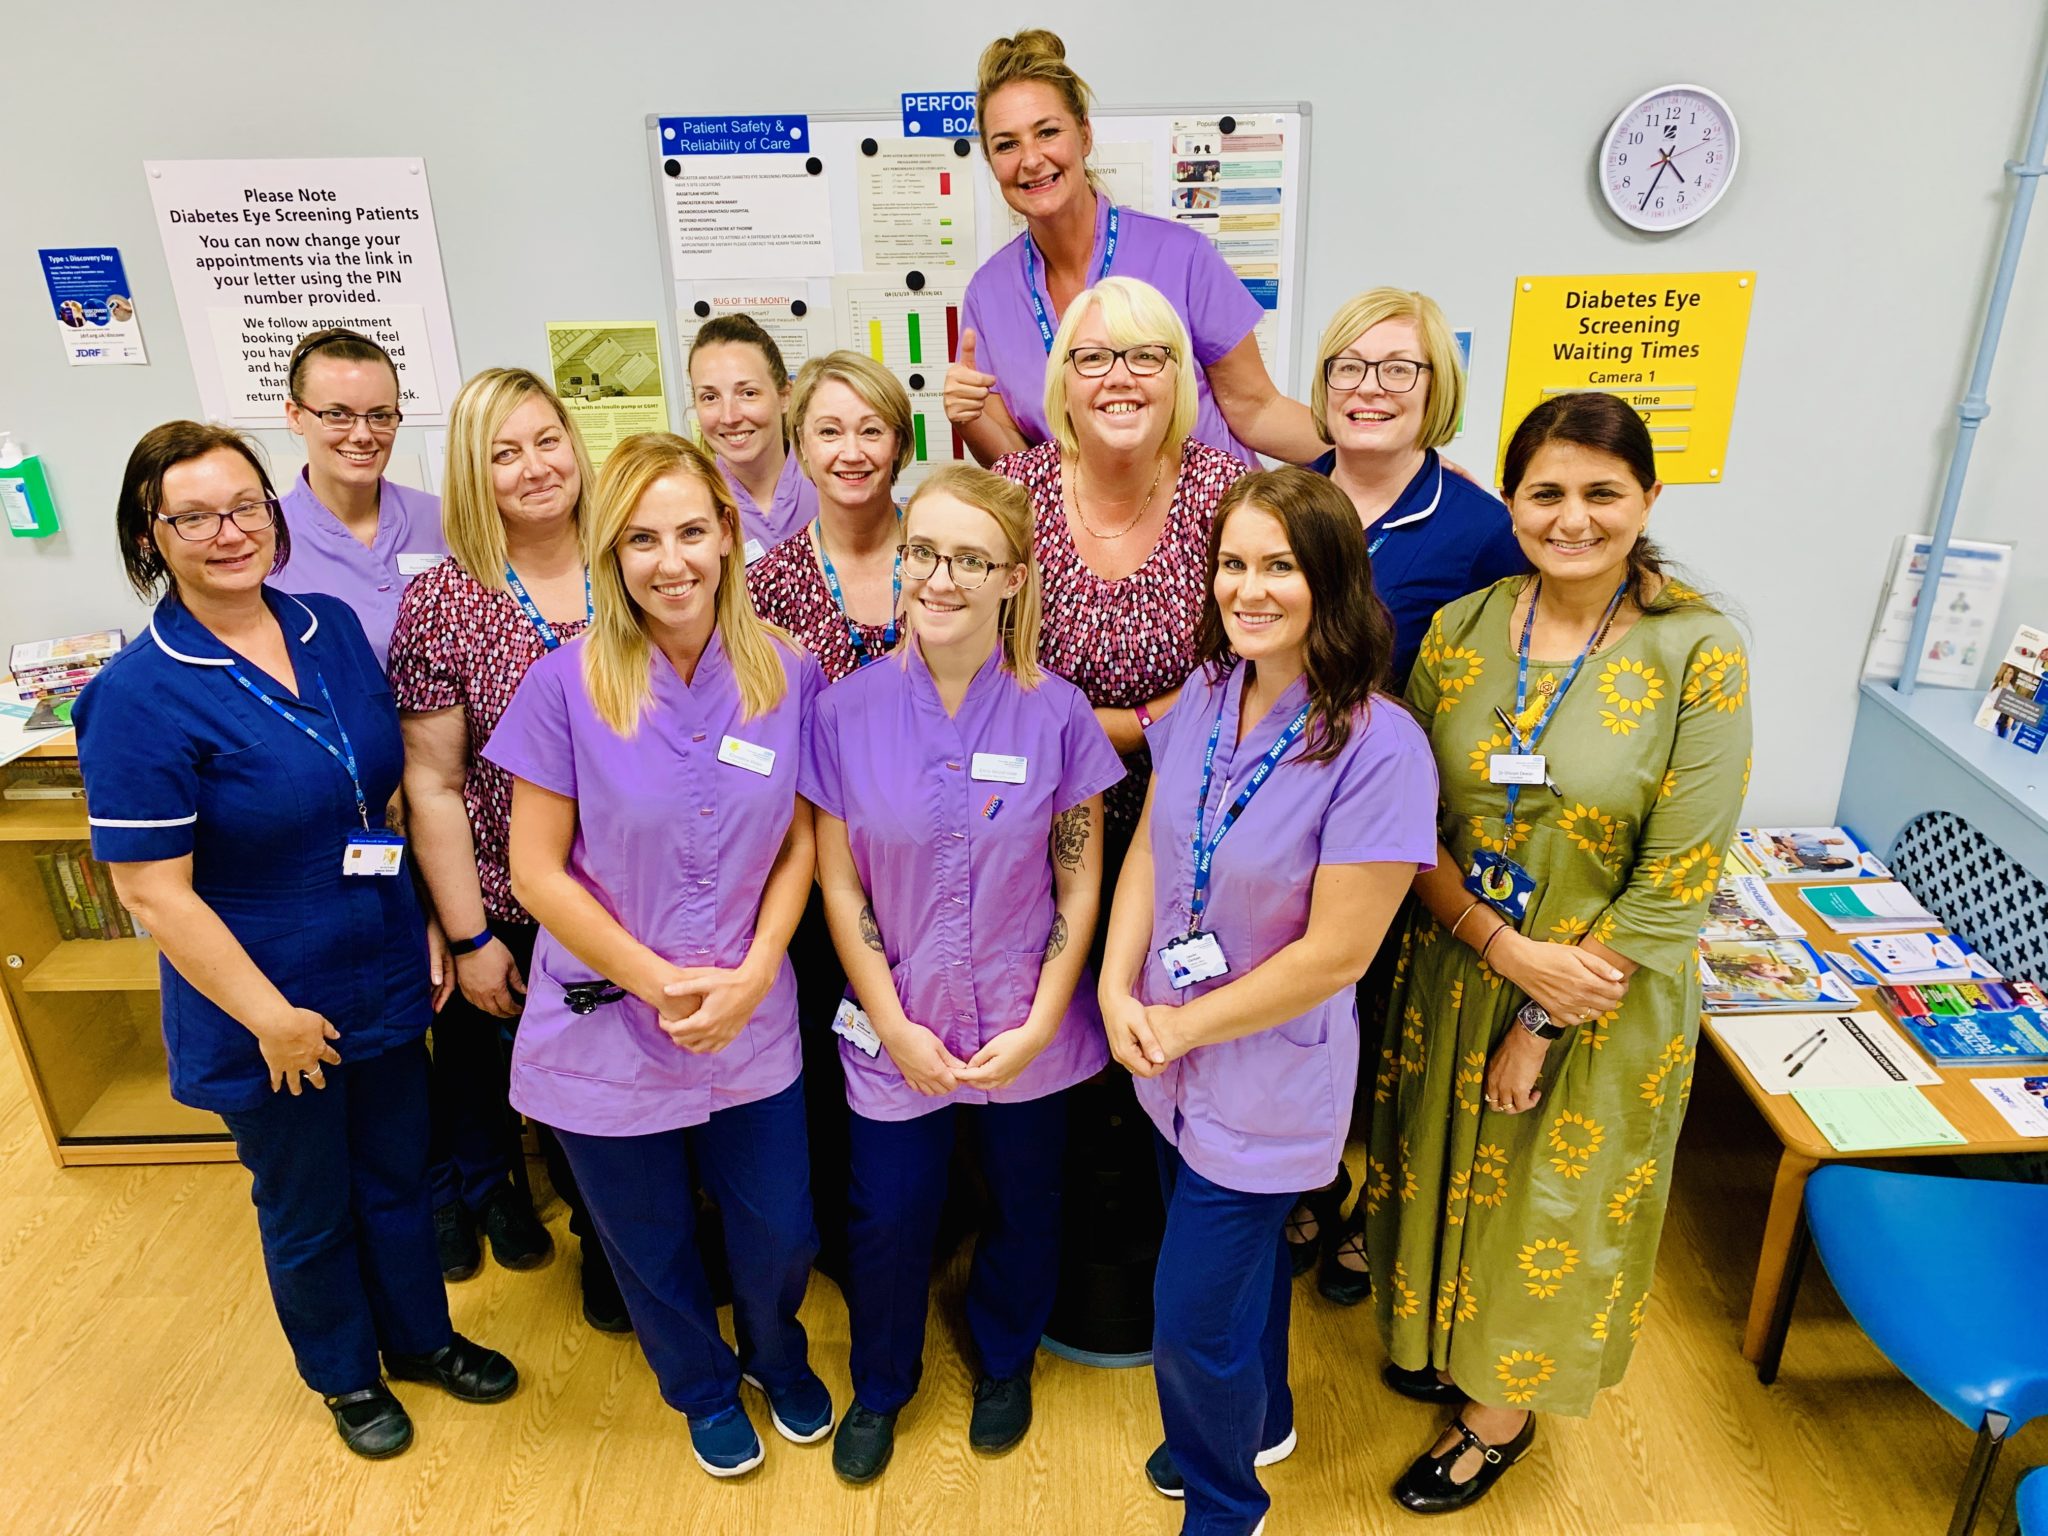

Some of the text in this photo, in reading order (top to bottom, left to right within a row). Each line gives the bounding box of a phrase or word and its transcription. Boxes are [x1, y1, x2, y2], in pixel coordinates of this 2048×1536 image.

[905, 96, 976, 112] PERFOR
[1646, 115, 1659, 126] 11
[1665, 107, 1681, 120] 12
[1690, 113, 1696, 124] 1
[683, 120, 784, 135] Patient Safety &
[1702, 128, 1711, 141] 2
[680, 138, 790, 153] Reliability of Care
[1628, 132, 1644, 144] 10
[1618, 153, 1627, 165] 9
[1705, 152, 1714, 164] 3
[1622, 176, 1630, 188] 8
[1694, 175, 1701, 186] 4
[244, 188, 336, 203] Please Note
[1638, 193, 1645, 204] 7
[1656, 197, 1664, 208] 6
[1677, 191, 1685, 204] 5
[170, 207, 419, 225] Diabetes Eye Screening Patients
[199, 233, 400, 249] You can now change your
[1107, 238, 1116, 257] NHS
[196, 251, 412, 270] appointments via the link in
[214, 270, 402, 290] your letter using the PIN
[244, 289, 381, 306] number provided.
[1565, 290, 1700, 312] Diabetes Eye
[243, 317, 392, 331] We follow appointment
[1040, 322, 1051, 339] NHS
[1579, 316, 1680, 337] Screening
[242, 332, 400, 346] booking feel
[76, 349, 101, 358] JDRF
[242, 350, 265, 360] you
[269, 348, 291, 358] hav
[1553, 342, 1700, 363] Waiting Times
[248, 362, 271, 372] and
[274, 362, 289, 372] ha
[1589, 371, 1656, 383] Camera 1
[247, 377, 419, 402] than return esk.
[1633, 395, 1660, 405] time
[1643, 413, 1651, 423] 2
[510, 580, 525, 597] NHS
[523, 602, 539, 619] NHS
[537, 623, 553, 640] NHS
[1289, 713, 1307, 734] NHS
[1270, 737, 1287, 759] NHS
[1252, 763, 1269, 785] NHS
[986, 800, 999, 816] NHS
[1212, 824, 1227, 846] NHS
[1200, 850, 1211, 872] NHS
[1842, 1018, 1904, 1080] YOUR OPINION COUNTS!
